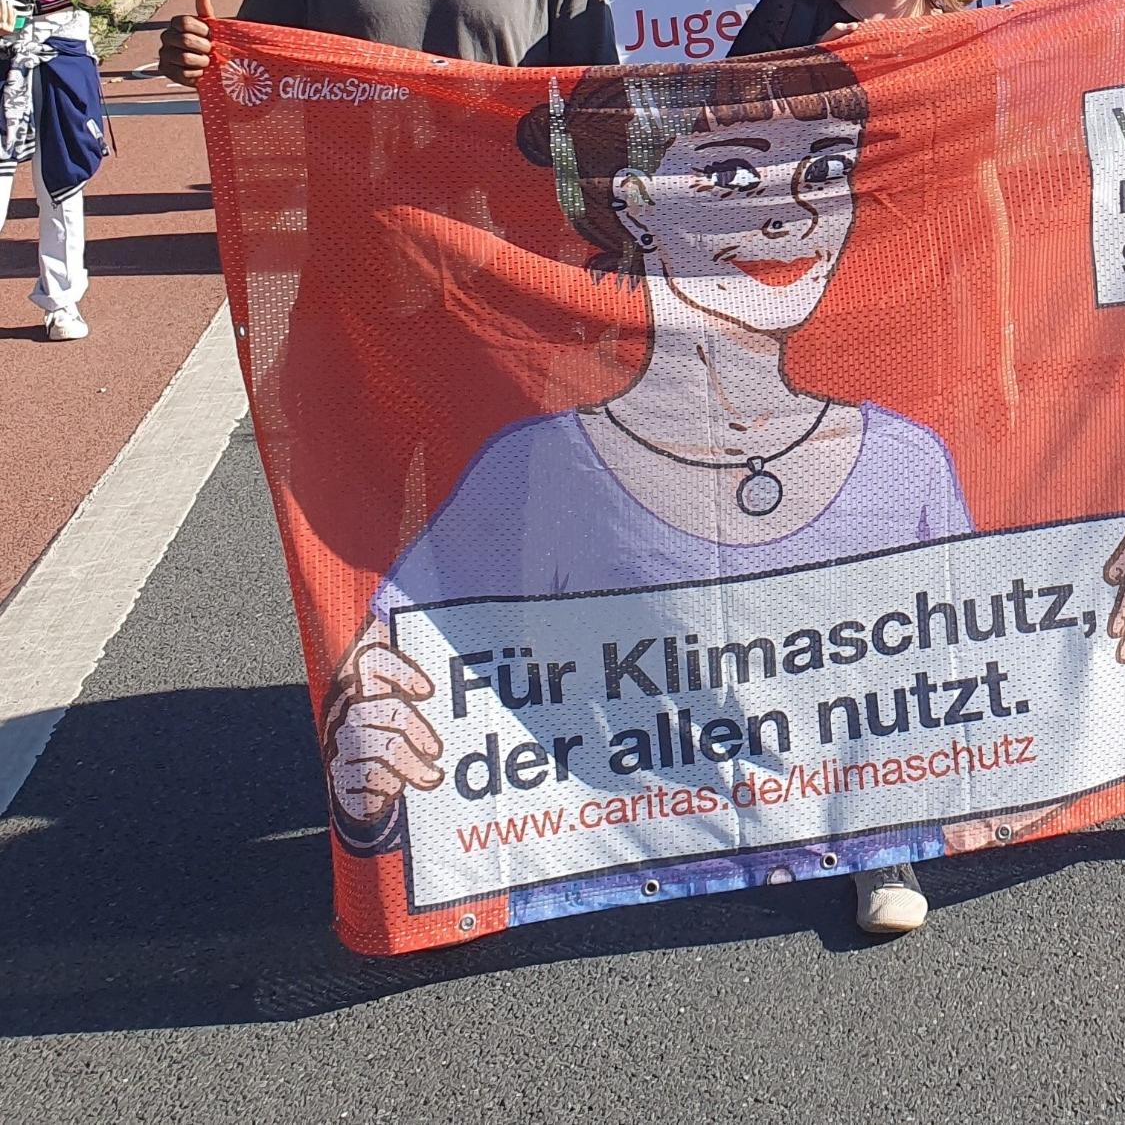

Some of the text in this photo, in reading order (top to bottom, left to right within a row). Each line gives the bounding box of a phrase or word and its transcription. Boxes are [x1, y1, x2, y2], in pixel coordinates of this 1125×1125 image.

[279, 76, 411, 106] GlücksSpirale
[624, 9, 745, 59] Juge
[447, 576, 1098, 720] Für Klimaschutz,
[453, 660, 1034, 803] der allen nutzt.
[455, 730, 1039, 856] www.caritas.de/klimaschutz
